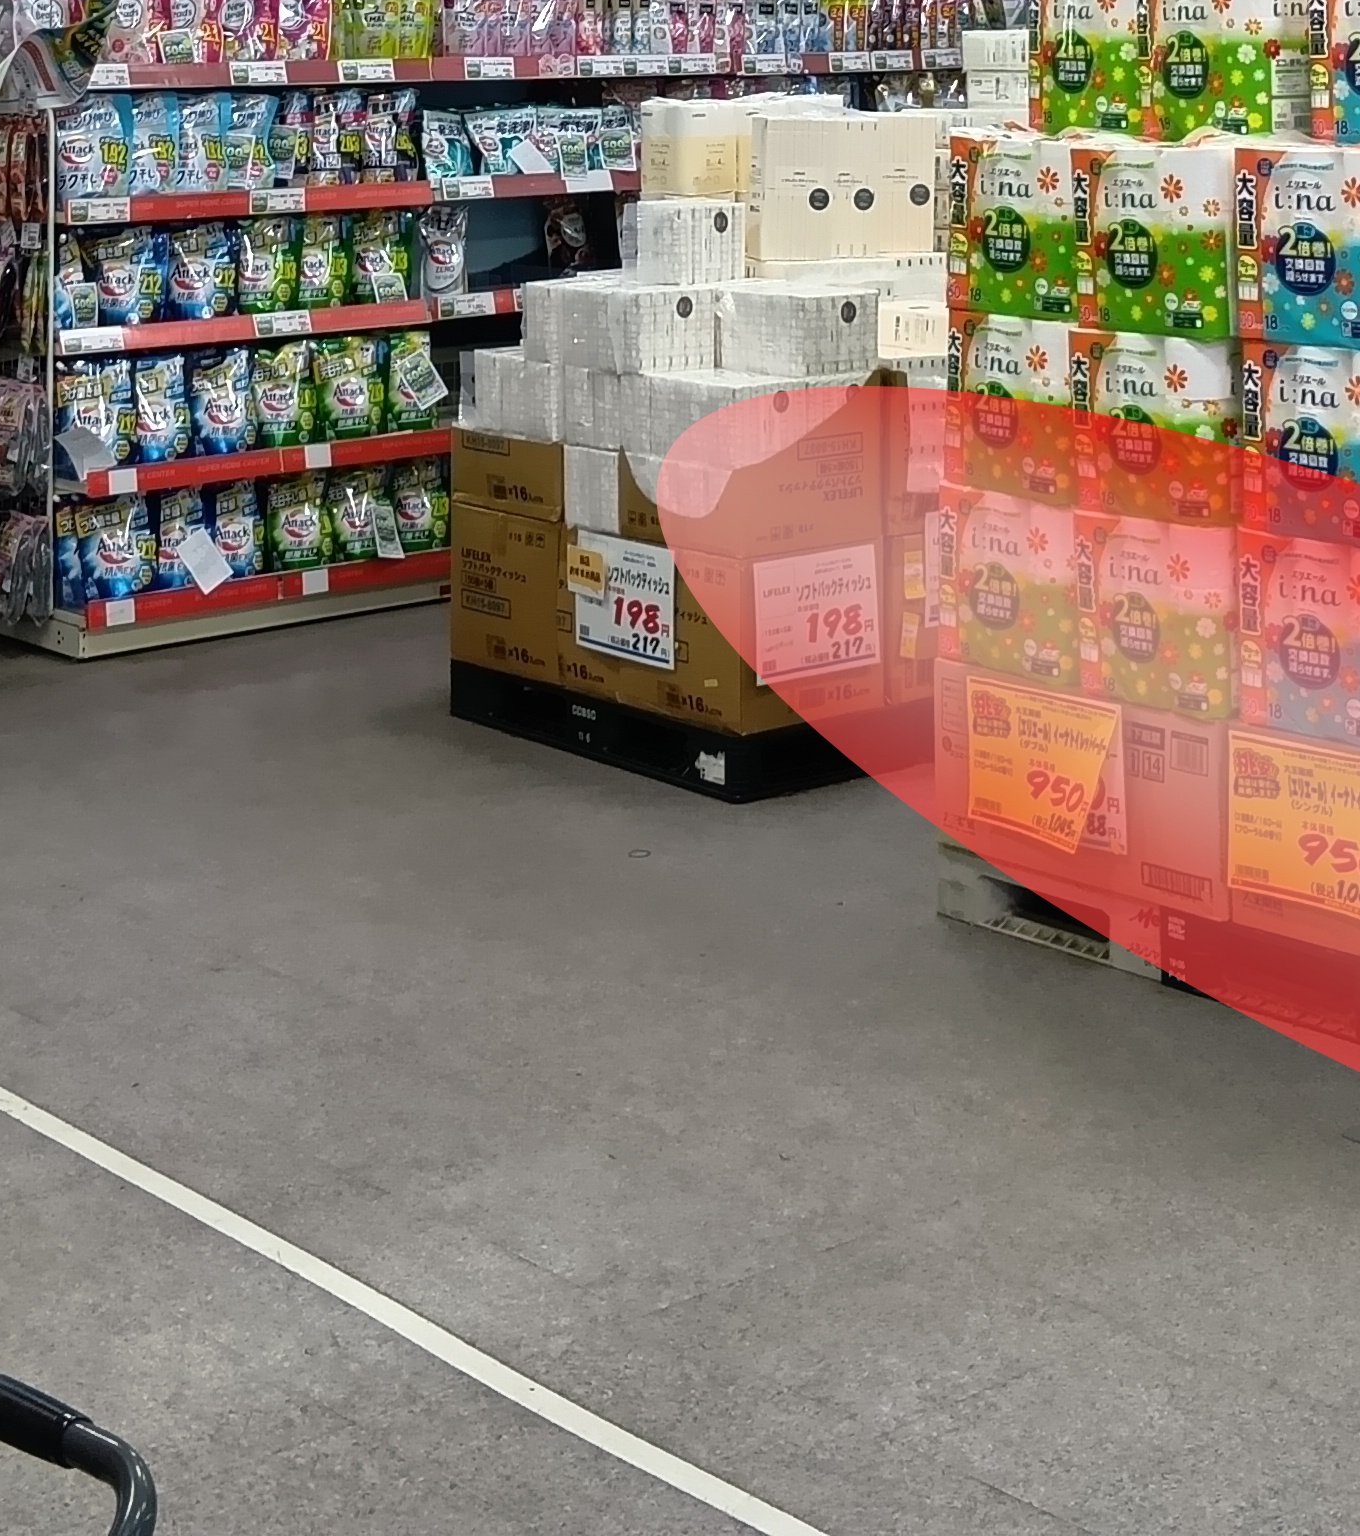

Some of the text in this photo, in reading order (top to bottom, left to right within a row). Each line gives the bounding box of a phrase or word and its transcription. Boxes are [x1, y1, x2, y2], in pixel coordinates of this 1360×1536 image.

[59, 142, 95, 155] Attack
[1237, 174, 1257, 249] 大容量
[101, 273, 135, 285] Attack
[172, 265, 209, 279] Attack
[260, 387, 295, 403] Attack
[281, 515, 318, 529] Attack
[216, 529, 250, 543] Attack
[461, 548, 491, 563] LIFELEX
[607, 566, 670, 595] ソフトパックティッシュ
[762, 585, 791, 598] LIFELEX
[796, 575, 872, 602] ソフトパックティッシュ
